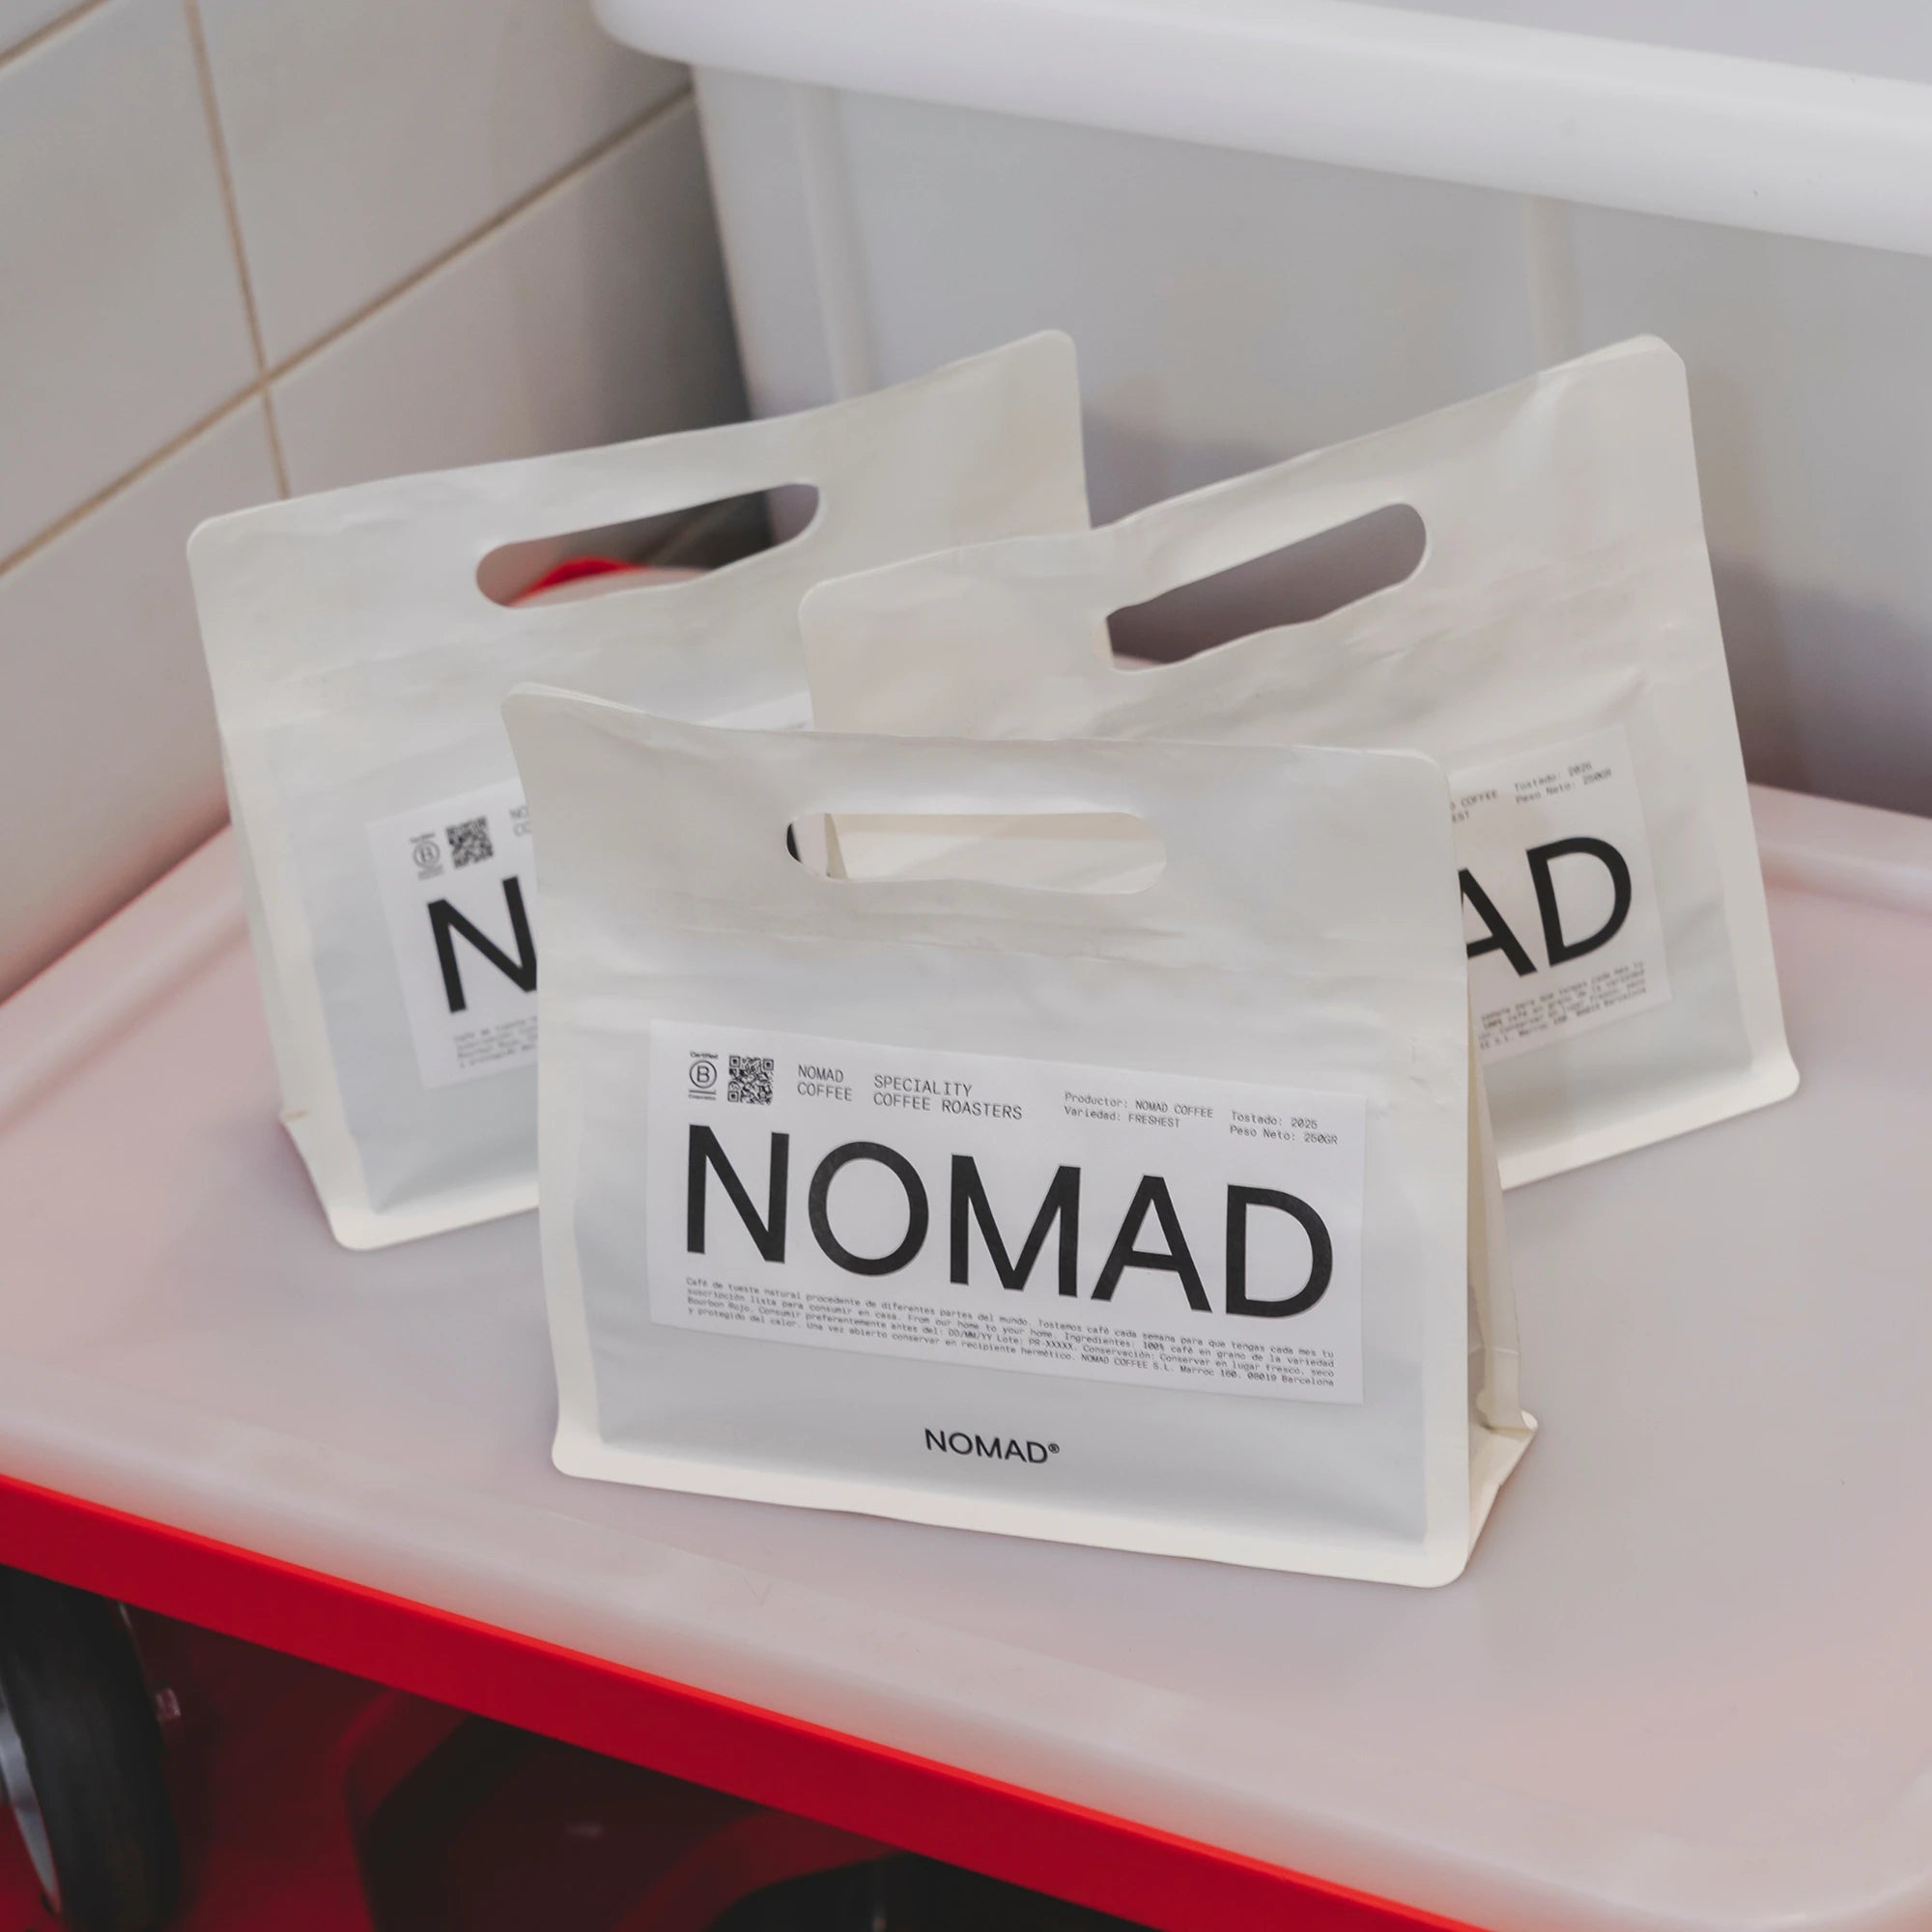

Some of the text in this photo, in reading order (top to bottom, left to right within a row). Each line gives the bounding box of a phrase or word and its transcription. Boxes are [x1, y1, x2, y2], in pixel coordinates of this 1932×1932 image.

[798, 1064, 844, 1083] NOMAD
[797, 1082, 854, 1101] COFFEE
[873, 1074, 973, 1097] SPECIALITY
[873, 1092, 1023, 1121] COFFEE ROASTERS
[1064, 1091, 1214, 1119] Productor: NOMAD COFFEE
[1064, 1105, 1181, 1128] Variedad: FRESHEST
[1232, 1110, 1318, 1130] Tostado: 2025
[1230, 1123, 1338, 1146] Peso Neto: 250GR
[687, 1123, 1333, 1319] NOMAD
